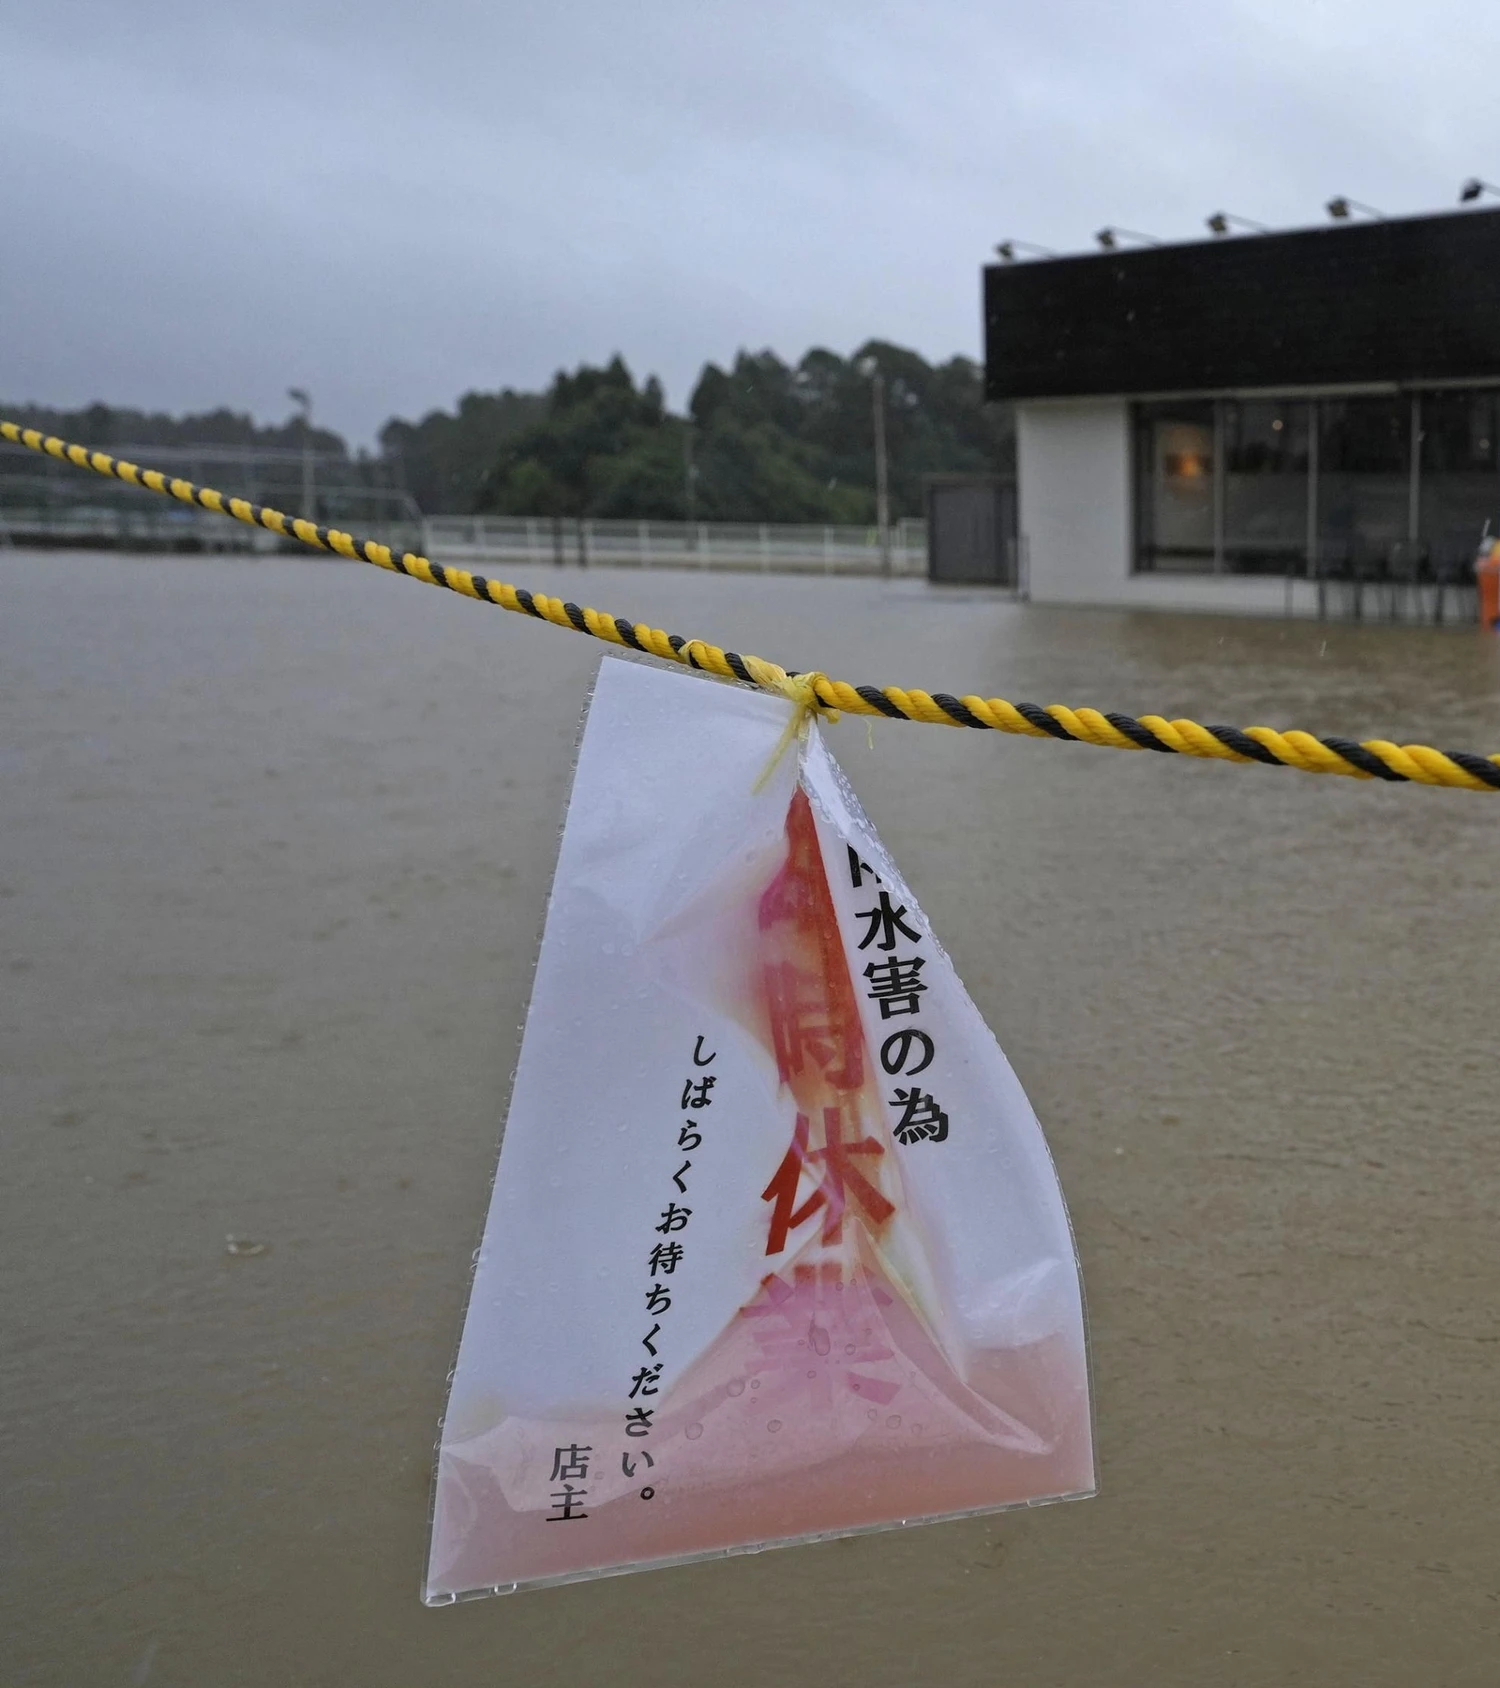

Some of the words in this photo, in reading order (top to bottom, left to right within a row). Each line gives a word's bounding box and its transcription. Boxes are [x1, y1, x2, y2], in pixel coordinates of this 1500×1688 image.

[621, 1034, 718, 1501] しばらくお待ちください。
[737, 786, 902, 1411] 時休業
[545, 1443, 593, 1522] 店主
